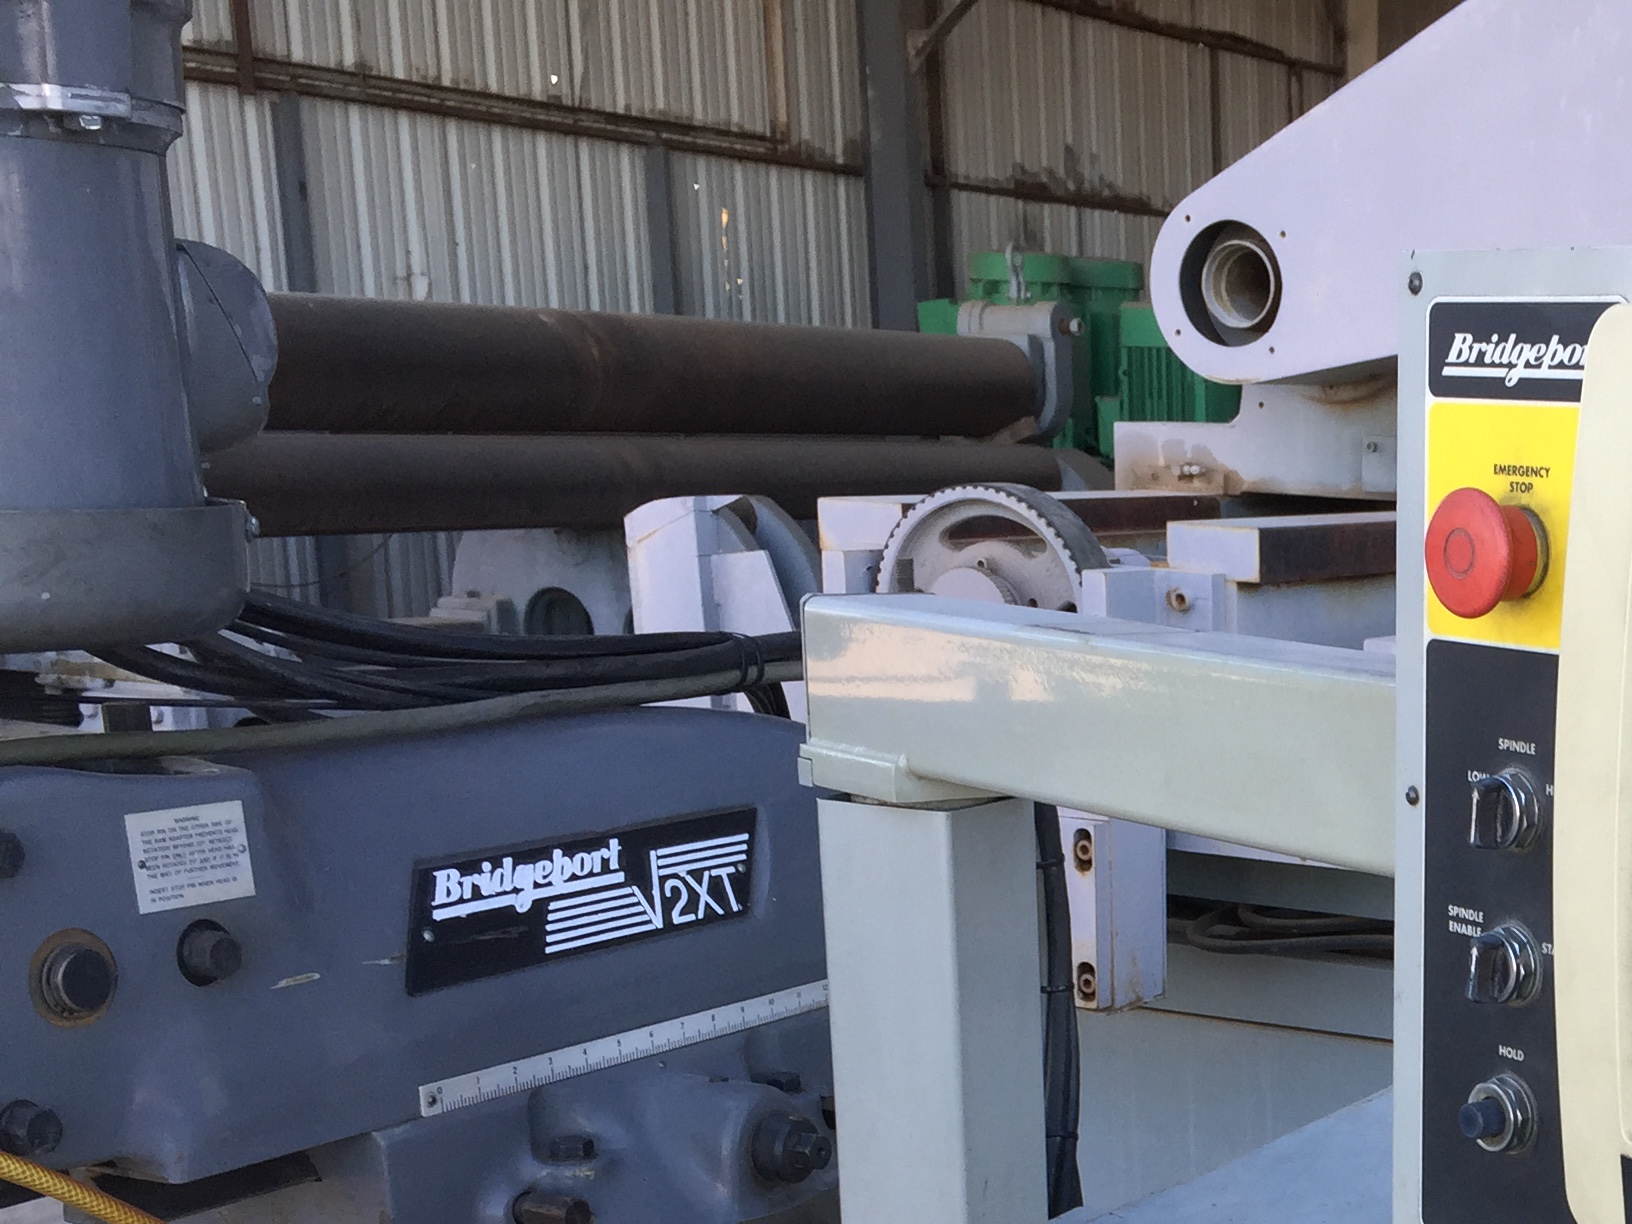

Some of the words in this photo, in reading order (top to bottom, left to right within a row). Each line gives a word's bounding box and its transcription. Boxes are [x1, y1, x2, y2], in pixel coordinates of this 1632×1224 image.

[1493, 463, 1551, 480] EMERGENCY
[1509, 480, 1534, 494] STOP
[1498, 737, 1536, 756] SPINDLE
[431, 837, 625, 921] Bridgeport
[1448, 904, 1484, 923] SPINDLE
[1448, 920, 1482, 938] ENABLE
[512, 1066, 518, 1075] 2
[547, 1057, 553, 1066] 3
[582, 1048, 588, 1057] 4
[648, 1031, 654, 1039] 6
[1498, 1044, 1525, 1062] HOLD
